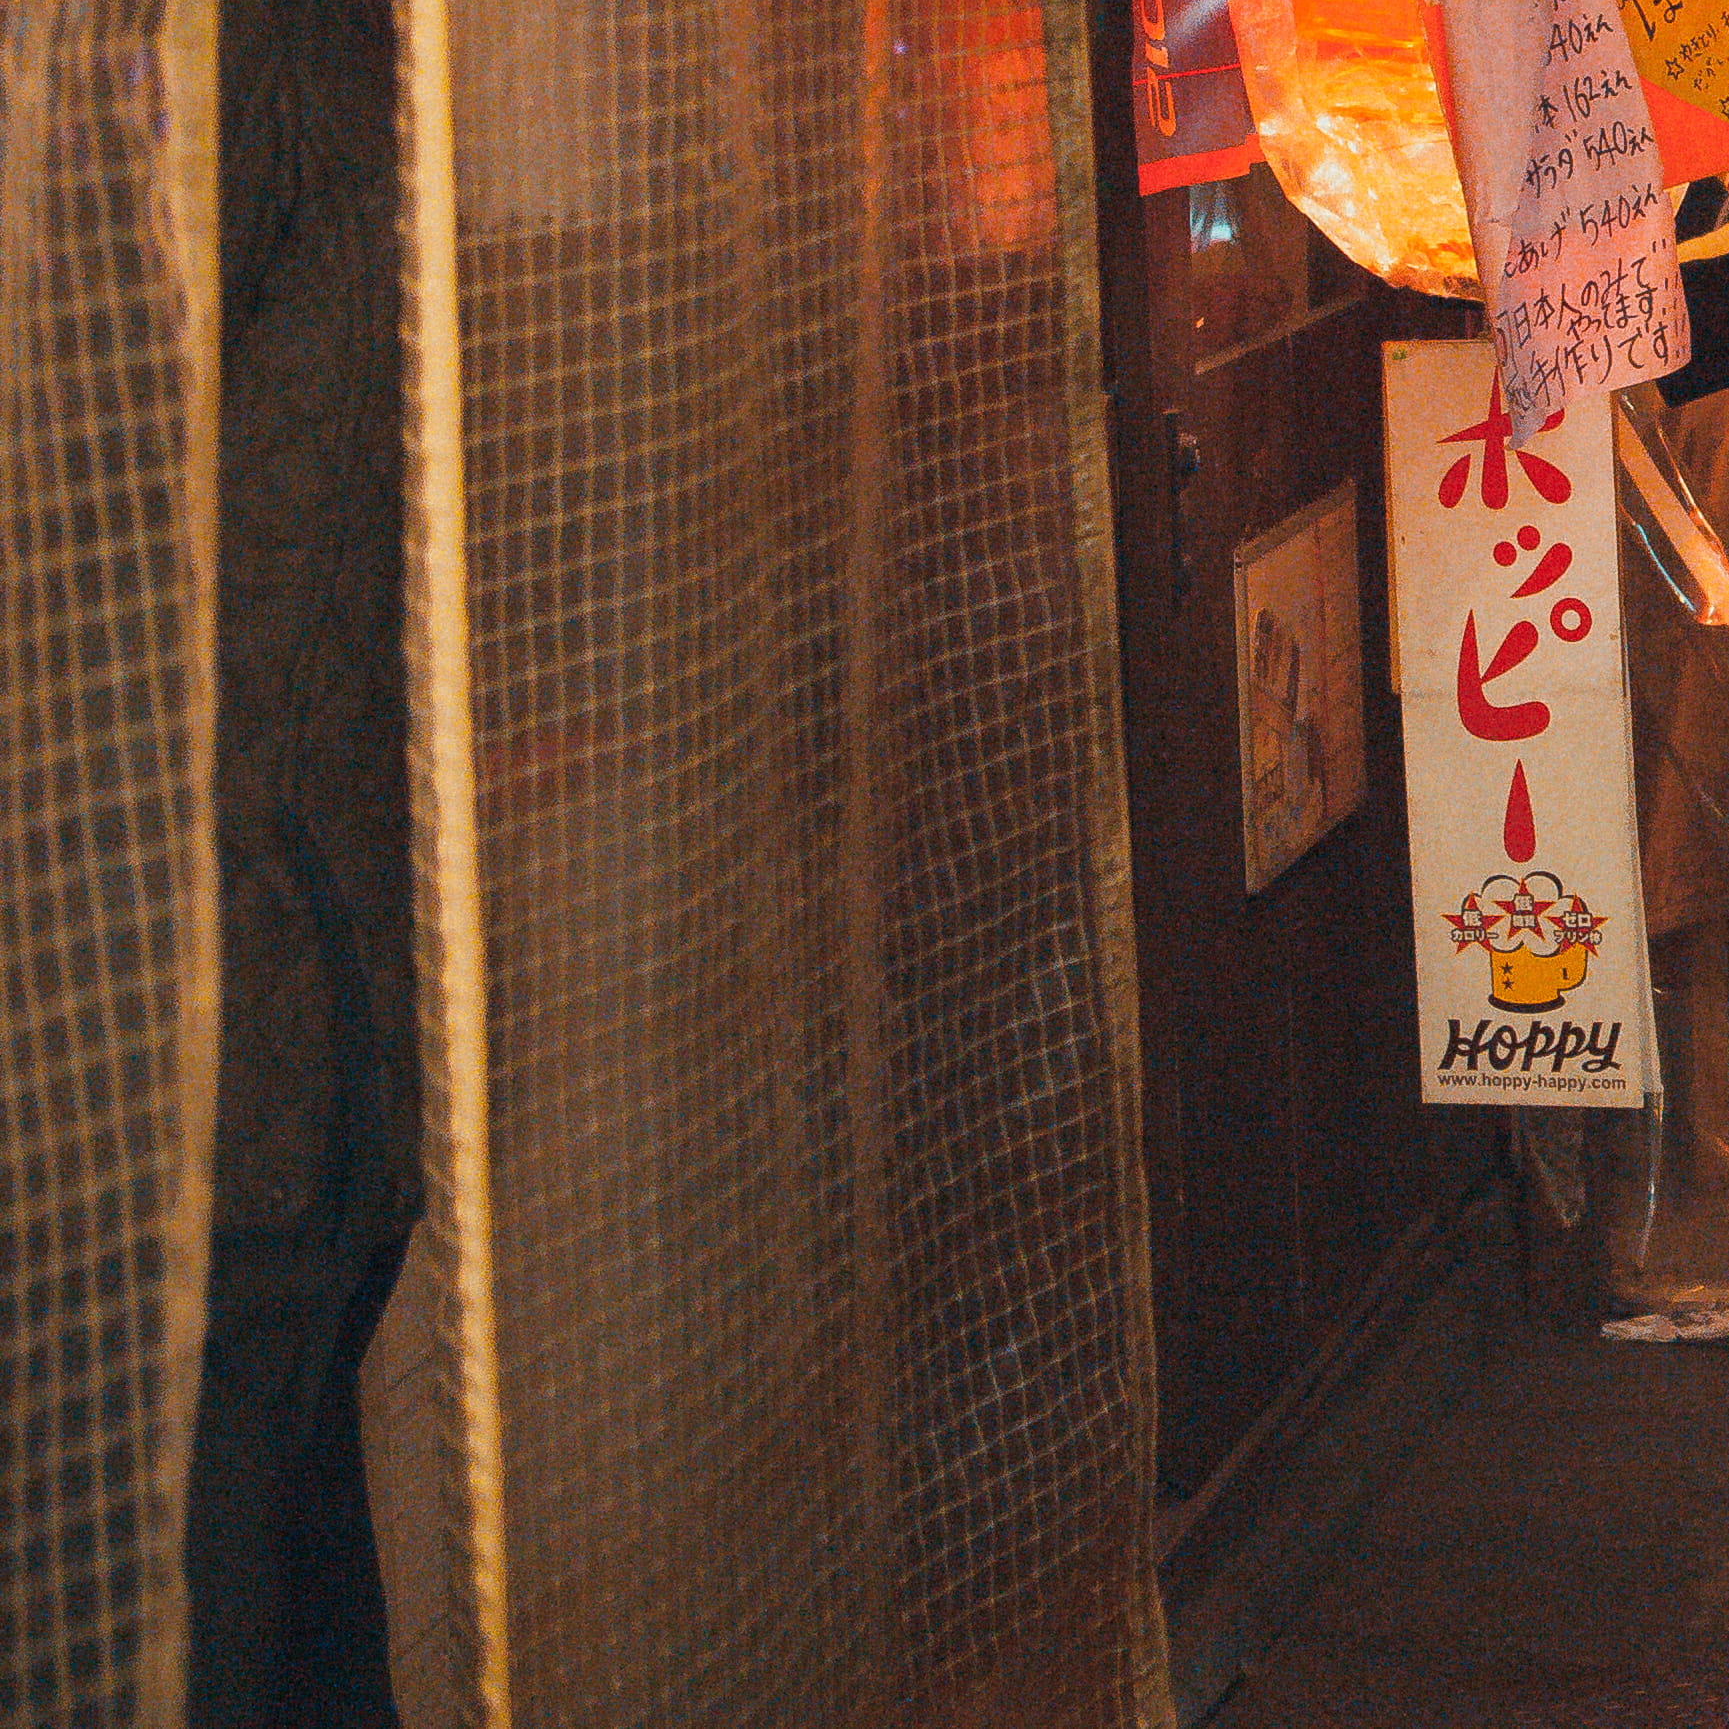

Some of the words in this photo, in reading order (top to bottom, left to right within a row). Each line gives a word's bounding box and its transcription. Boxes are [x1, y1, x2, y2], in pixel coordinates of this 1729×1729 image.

[1435, 365, 1592, 863] ホッピー
[1562, 911, 1593, 928] ゼロ
[1451, 929, 1499, 943] カロリー
[1437, 1072, 1627, 1092] www.hoppy-happy.com
